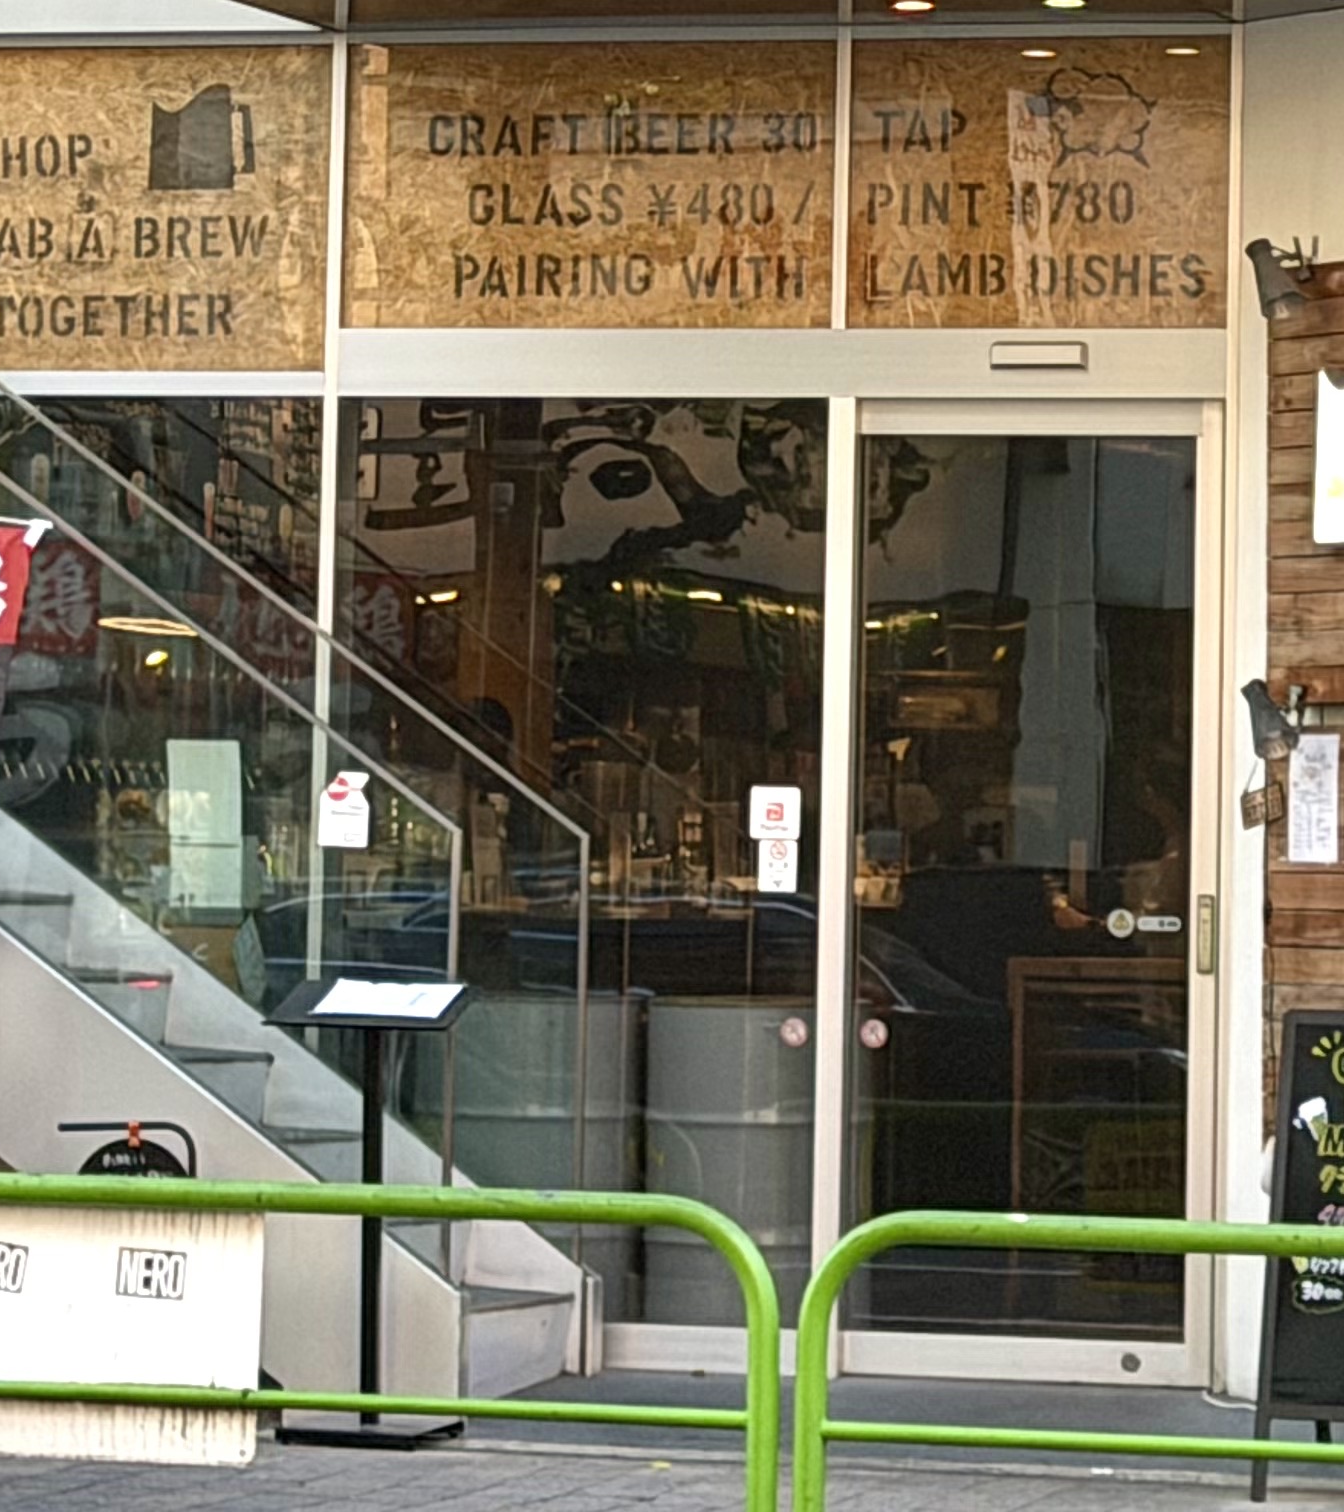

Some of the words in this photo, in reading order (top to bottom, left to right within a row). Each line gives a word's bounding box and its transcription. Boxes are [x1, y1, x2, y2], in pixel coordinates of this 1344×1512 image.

[428, 113, 587, 156] CRAFT
[609, 112, 735, 155] BEER
[763, 112, 817, 153] 30
[873, 109, 967, 153] TAP
[468, 183, 624, 226] GLASS
[647, 183, 775, 226] ¥480
[867, 182, 986, 227] PINT
[77, 218, 104, 259] A
[134, 215, 269, 259] BREW
[455, 253, 652, 299] PAIRING
[681, 254, 805, 300] WITH
[867, 253, 1005, 298] LAMB
[1030, 253, 1207, 298] DISHES
